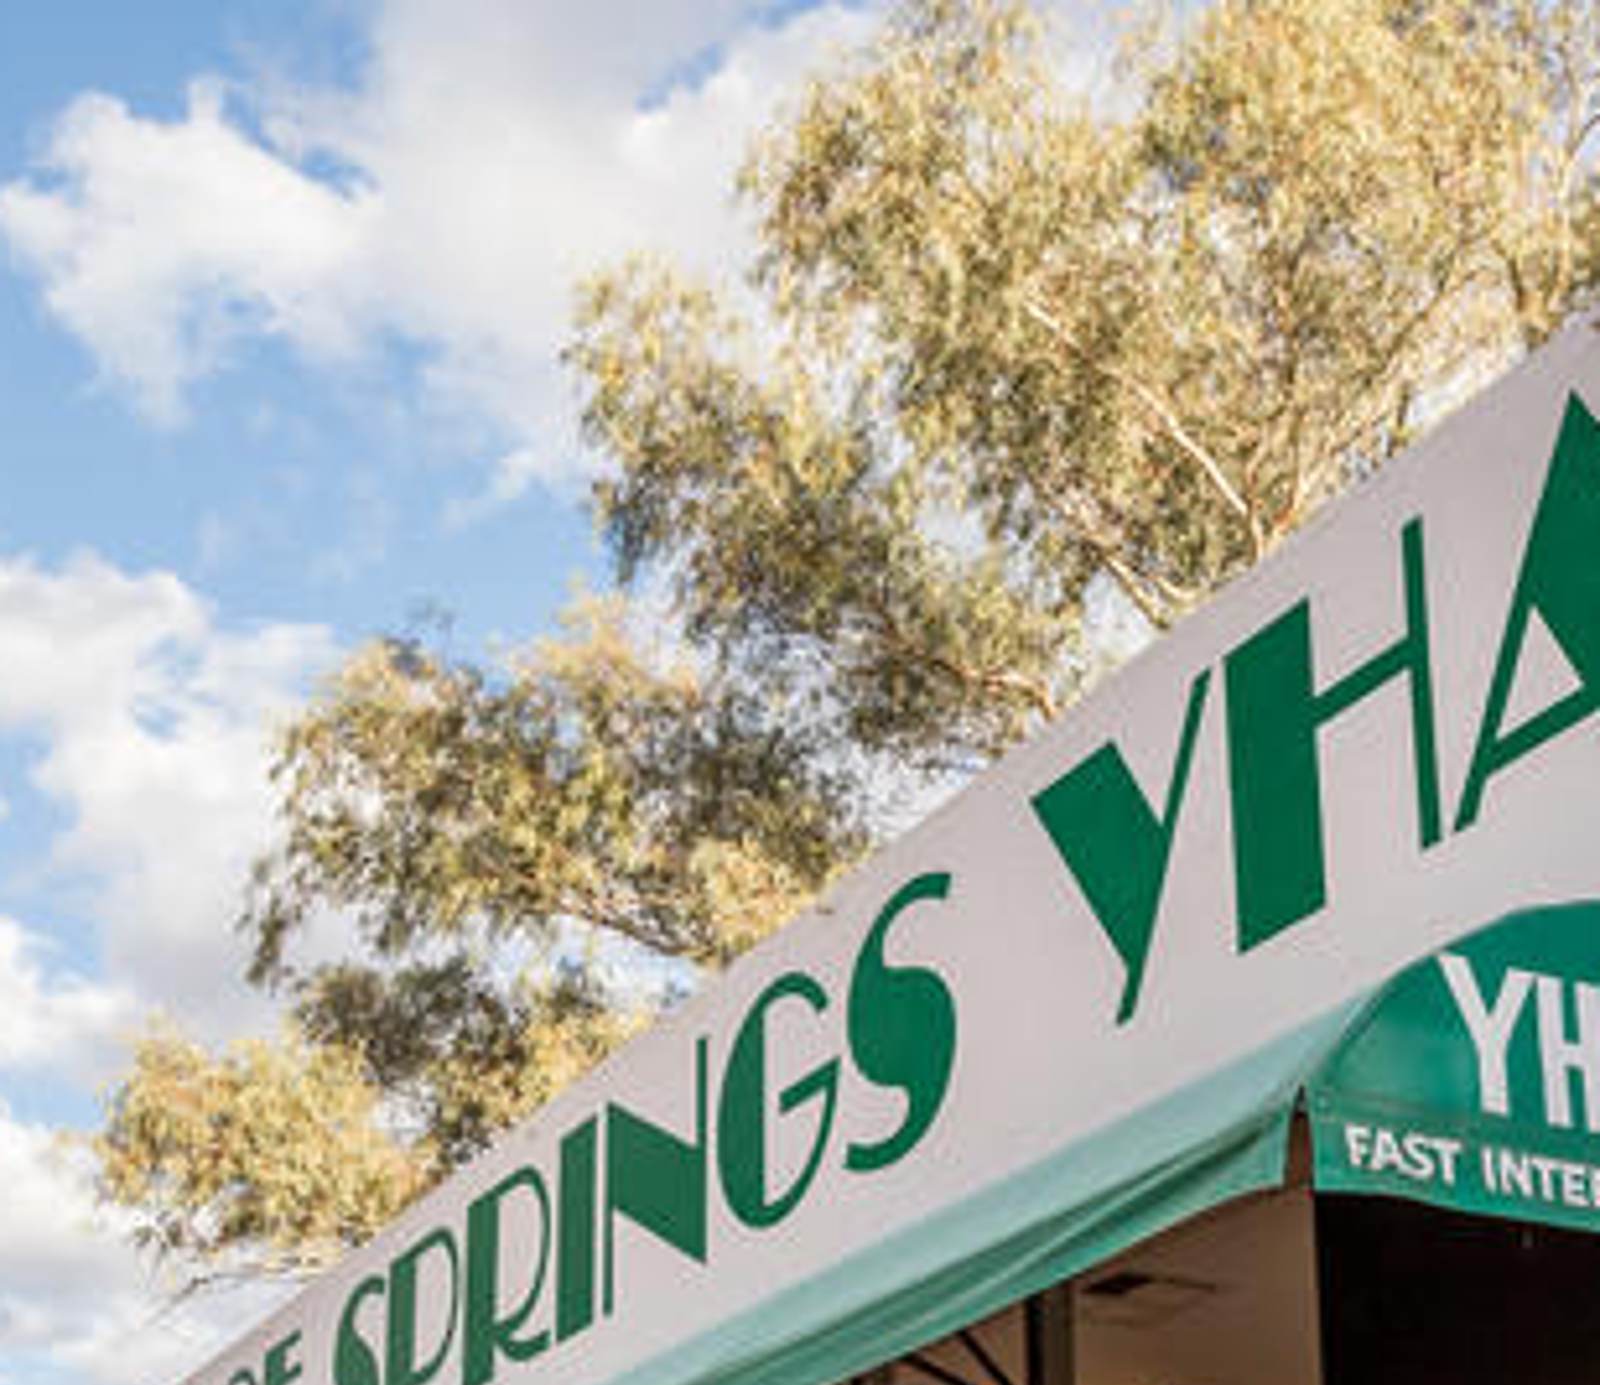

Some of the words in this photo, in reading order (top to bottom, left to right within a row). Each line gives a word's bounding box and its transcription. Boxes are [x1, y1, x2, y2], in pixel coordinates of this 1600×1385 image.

[1030, 388, 1600, 1025] YHA
[1344, 1122, 1462, 1185] FAST
[1482, 1148, 1600, 1211] INTE
